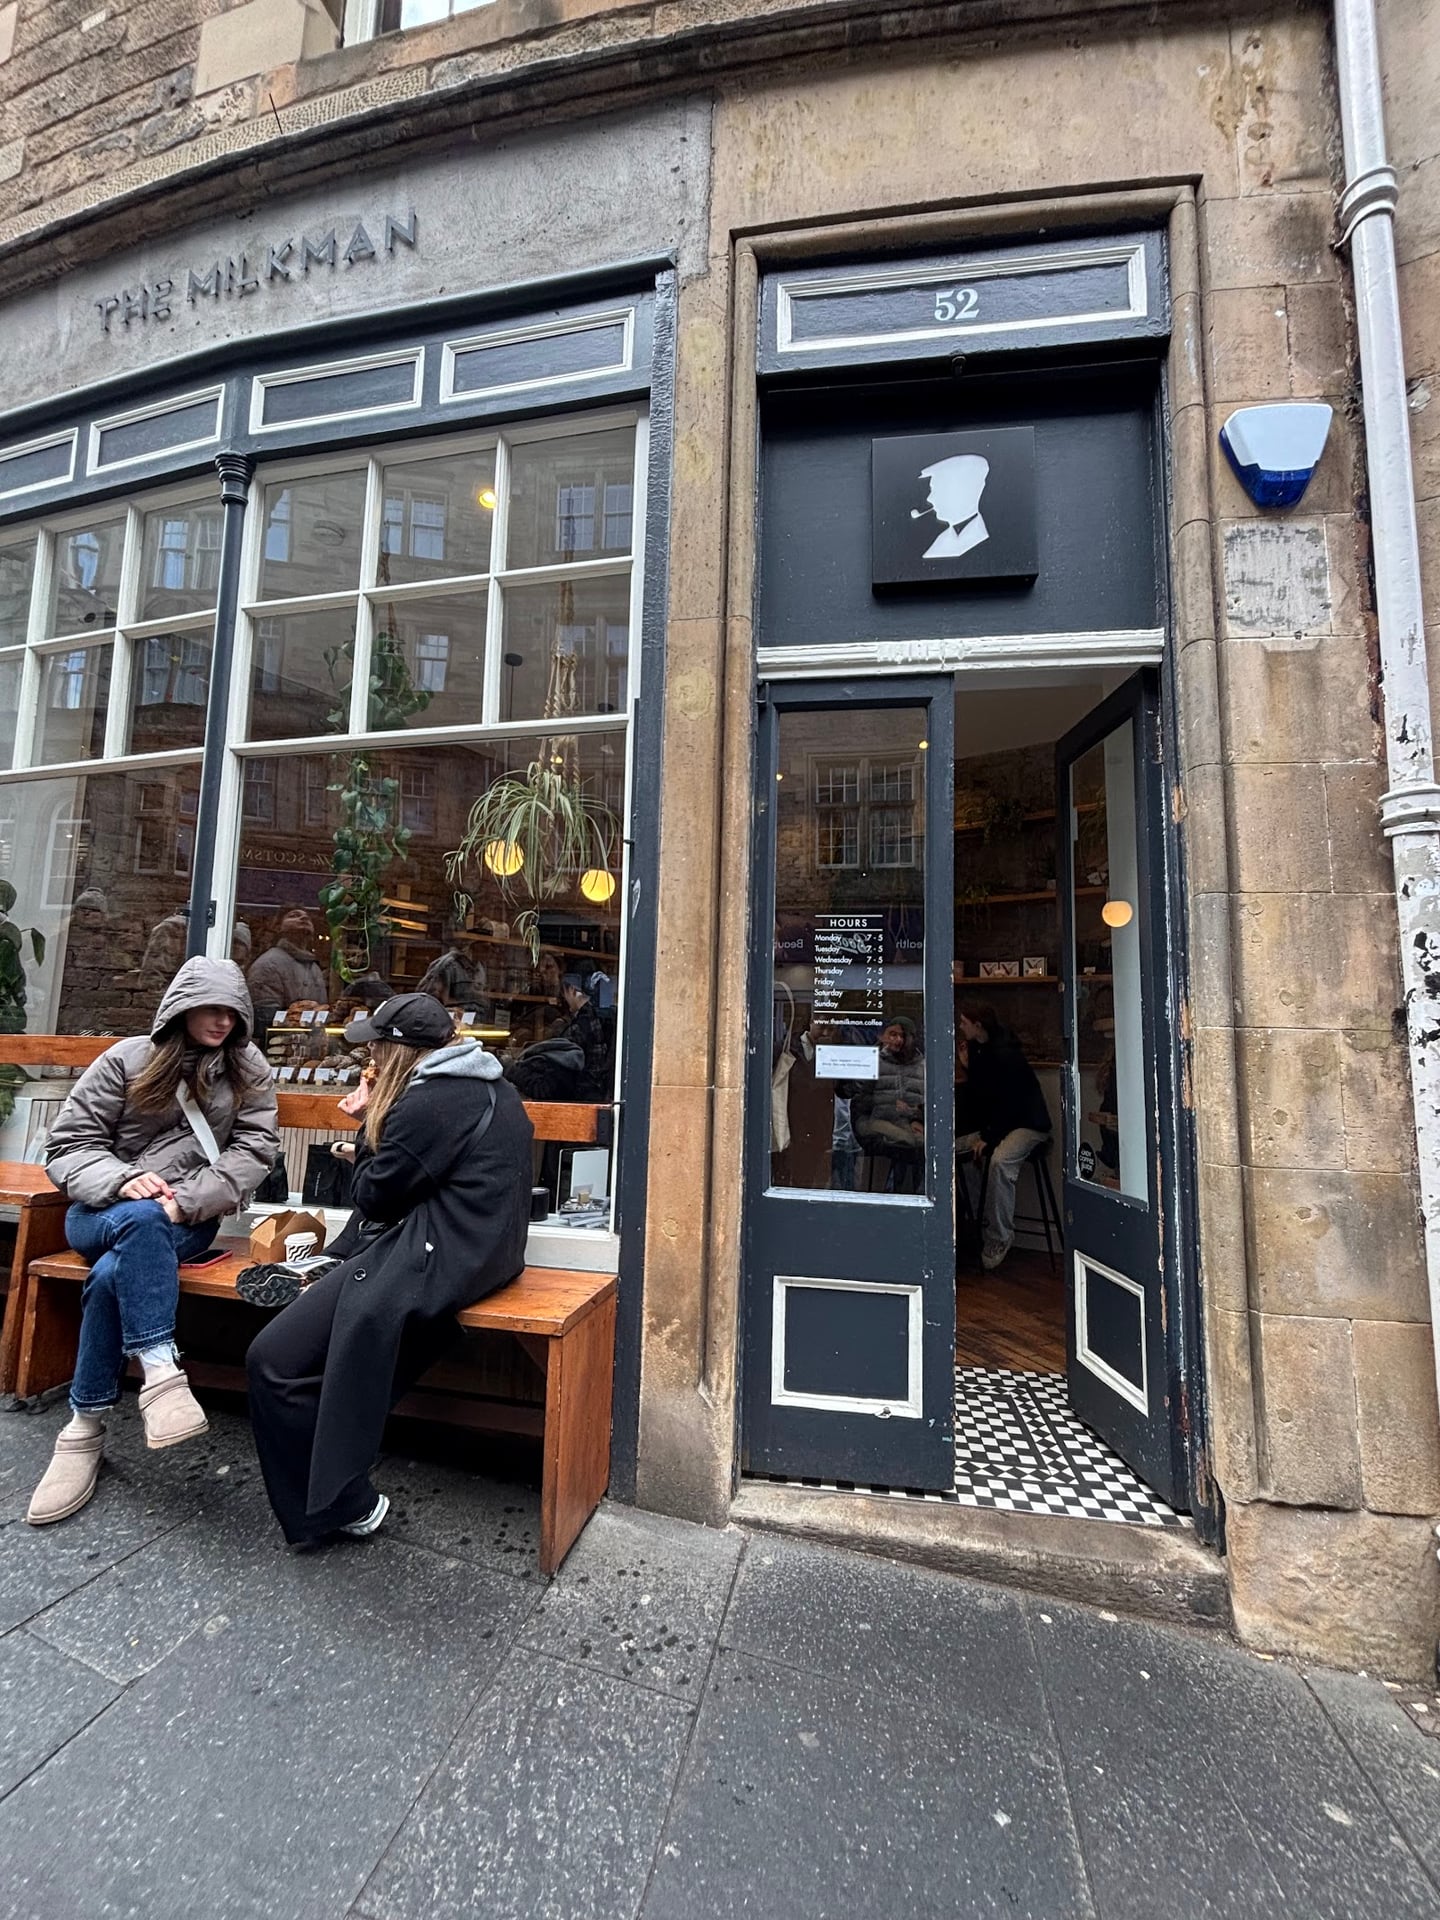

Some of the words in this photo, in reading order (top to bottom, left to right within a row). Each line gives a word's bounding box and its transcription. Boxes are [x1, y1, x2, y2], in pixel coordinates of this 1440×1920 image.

[95, 279, 173, 332] THE
[186, 207, 418, 303] MILKMAN
[934, 288, 980, 321] 52
[829, 919, 868, 927] HOURS
[814, 934, 842, 942] Monday
[814, 945, 841, 954] Tuesday
[814, 956, 853, 965] Wednesday
[866, 956, 872, 964] 7
[877, 956, 883, 964] 5
[814, 967, 844, 976] Thursday
[866, 967, 872, 975] 7
[877, 967, 883, 975] 5
[814, 978, 835, 986] Friday
[814, 989, 843, 998] Saturday
[814, 1000, 838, 1009] Sunday
[813, 1018, 883, 1026] www.themilkman.coffee
